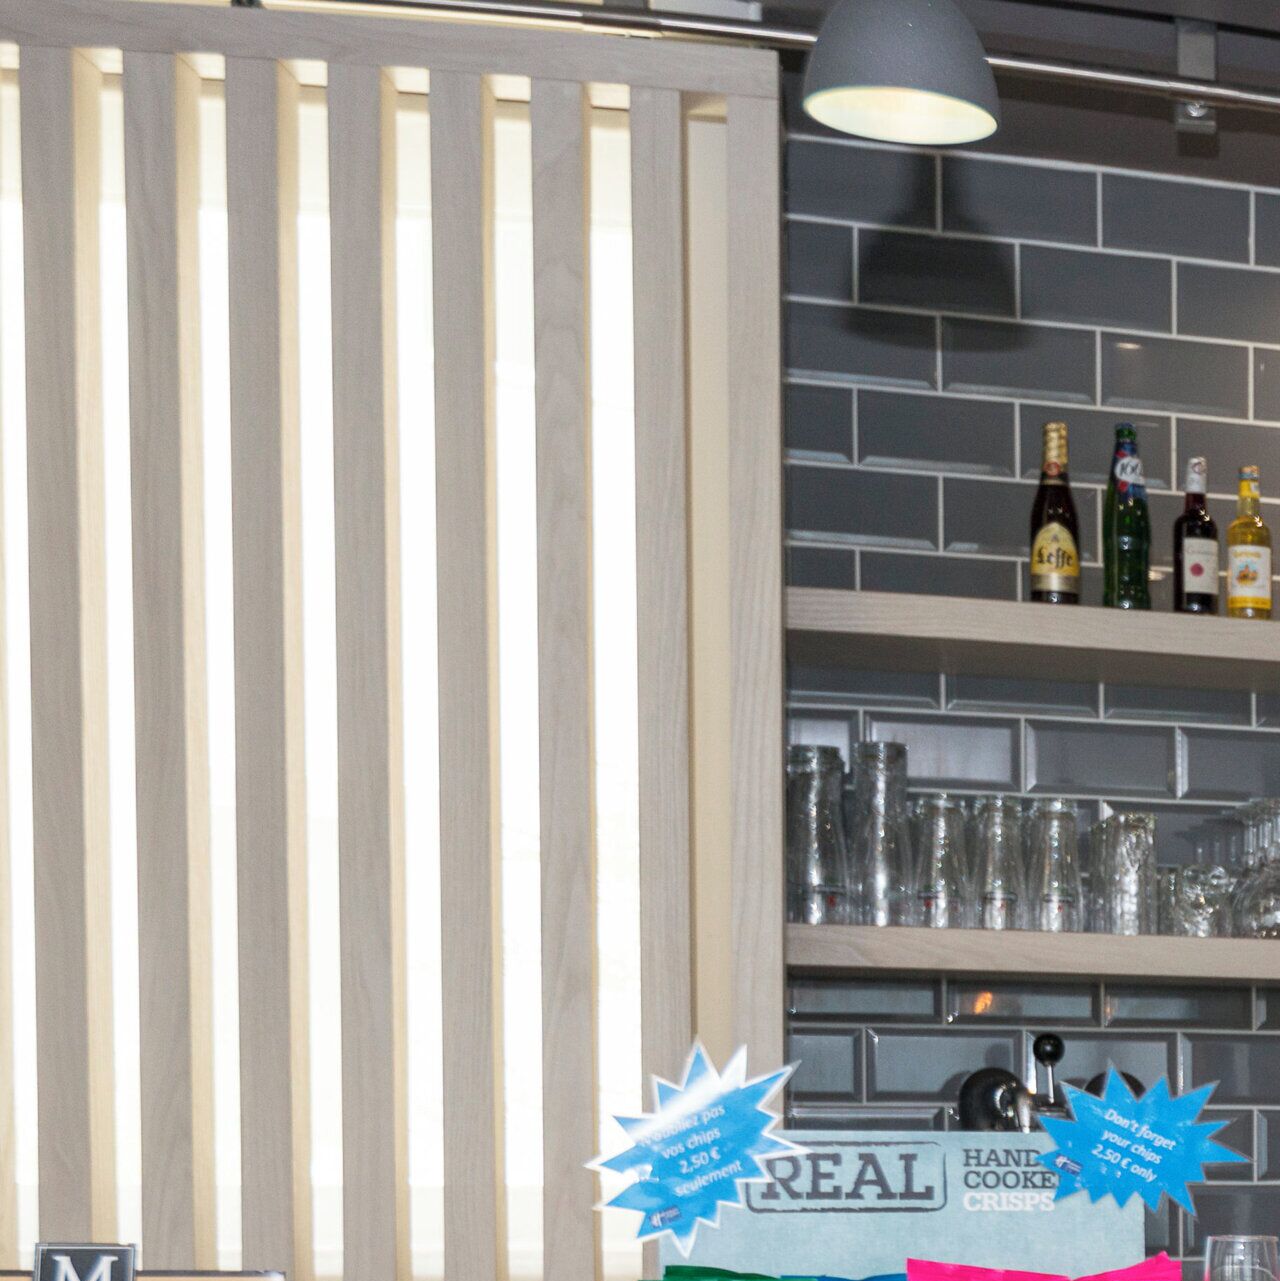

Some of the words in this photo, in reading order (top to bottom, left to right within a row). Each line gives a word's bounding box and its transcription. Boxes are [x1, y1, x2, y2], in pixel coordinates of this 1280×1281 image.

[1036, 547, 1074, 569] Leffe
[702, 1104, 725, 1125] pas
[1104, 1109, 1137, 1133] Don't
[1135, 1126, 1176, 1151] forget
[661, 1144, 685, 1160] vos
[688, 1128, 721, 1149] chips
[1101, 1130, 1131, 1150] your
[1130, 1142, 1163, 1164] chips
[680, 1154, 709, 1174] 2,50
[710, 1147, 721, 1161] €
[1120, 1157, 1132, 1169] €
[1130, 1164, 1157, 1182] only
[675, 1160, 743, 1197] seulement
[761, 1153, 934, 1200] REAL
[963, 1170, 1058, 1189] COOKE
[963, 1192, 1057, 1212] CRISPS
